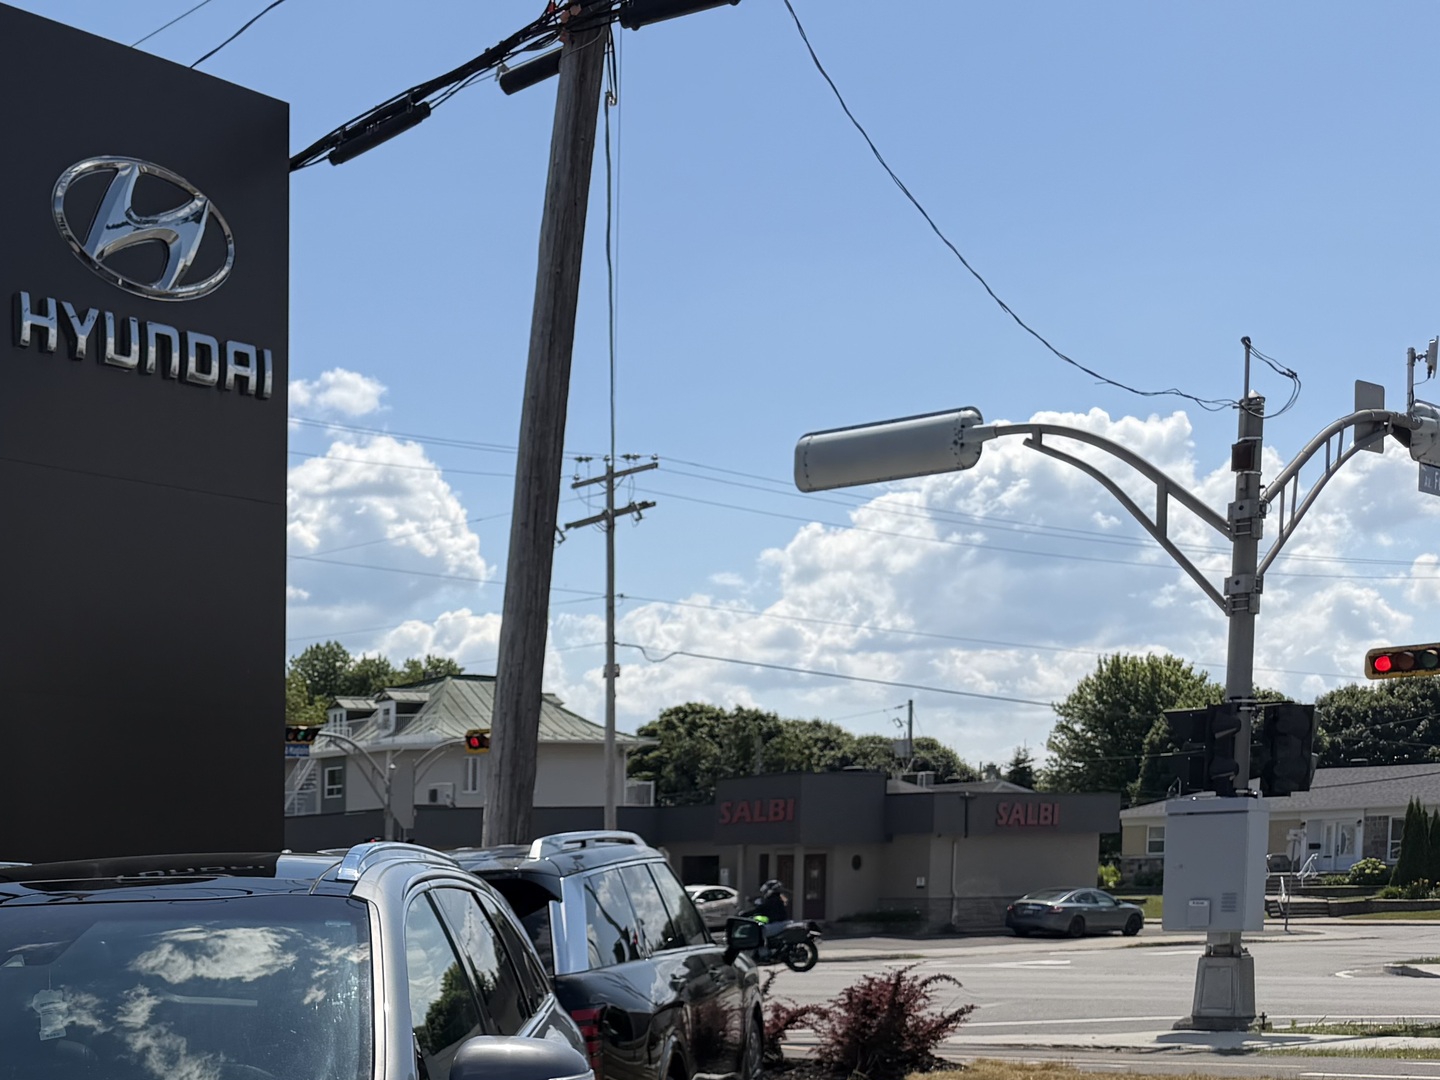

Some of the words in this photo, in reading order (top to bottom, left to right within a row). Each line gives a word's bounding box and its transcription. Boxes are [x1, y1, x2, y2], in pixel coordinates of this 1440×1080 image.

[19, 291, 273, 399] HYUNDAI
[719, 798, 796, 824] SALBI
[996, 802, 1060, 826] SALBI
